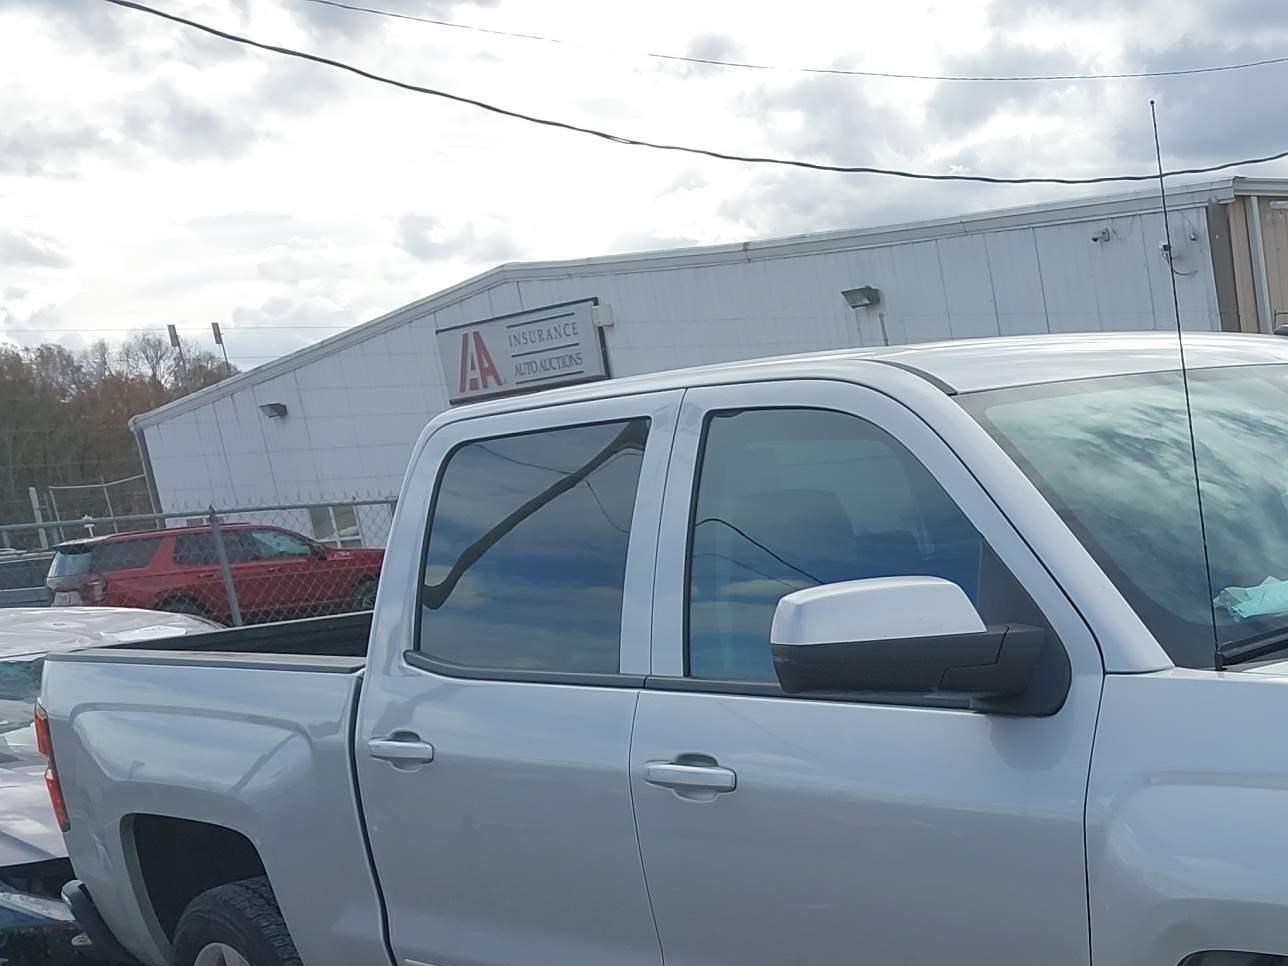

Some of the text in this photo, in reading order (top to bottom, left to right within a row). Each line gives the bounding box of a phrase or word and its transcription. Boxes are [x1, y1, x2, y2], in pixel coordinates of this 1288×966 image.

[508, 322, 578, 348] INSURANCE
[514, 352, 584, 377] AUTO AUCTIONS
